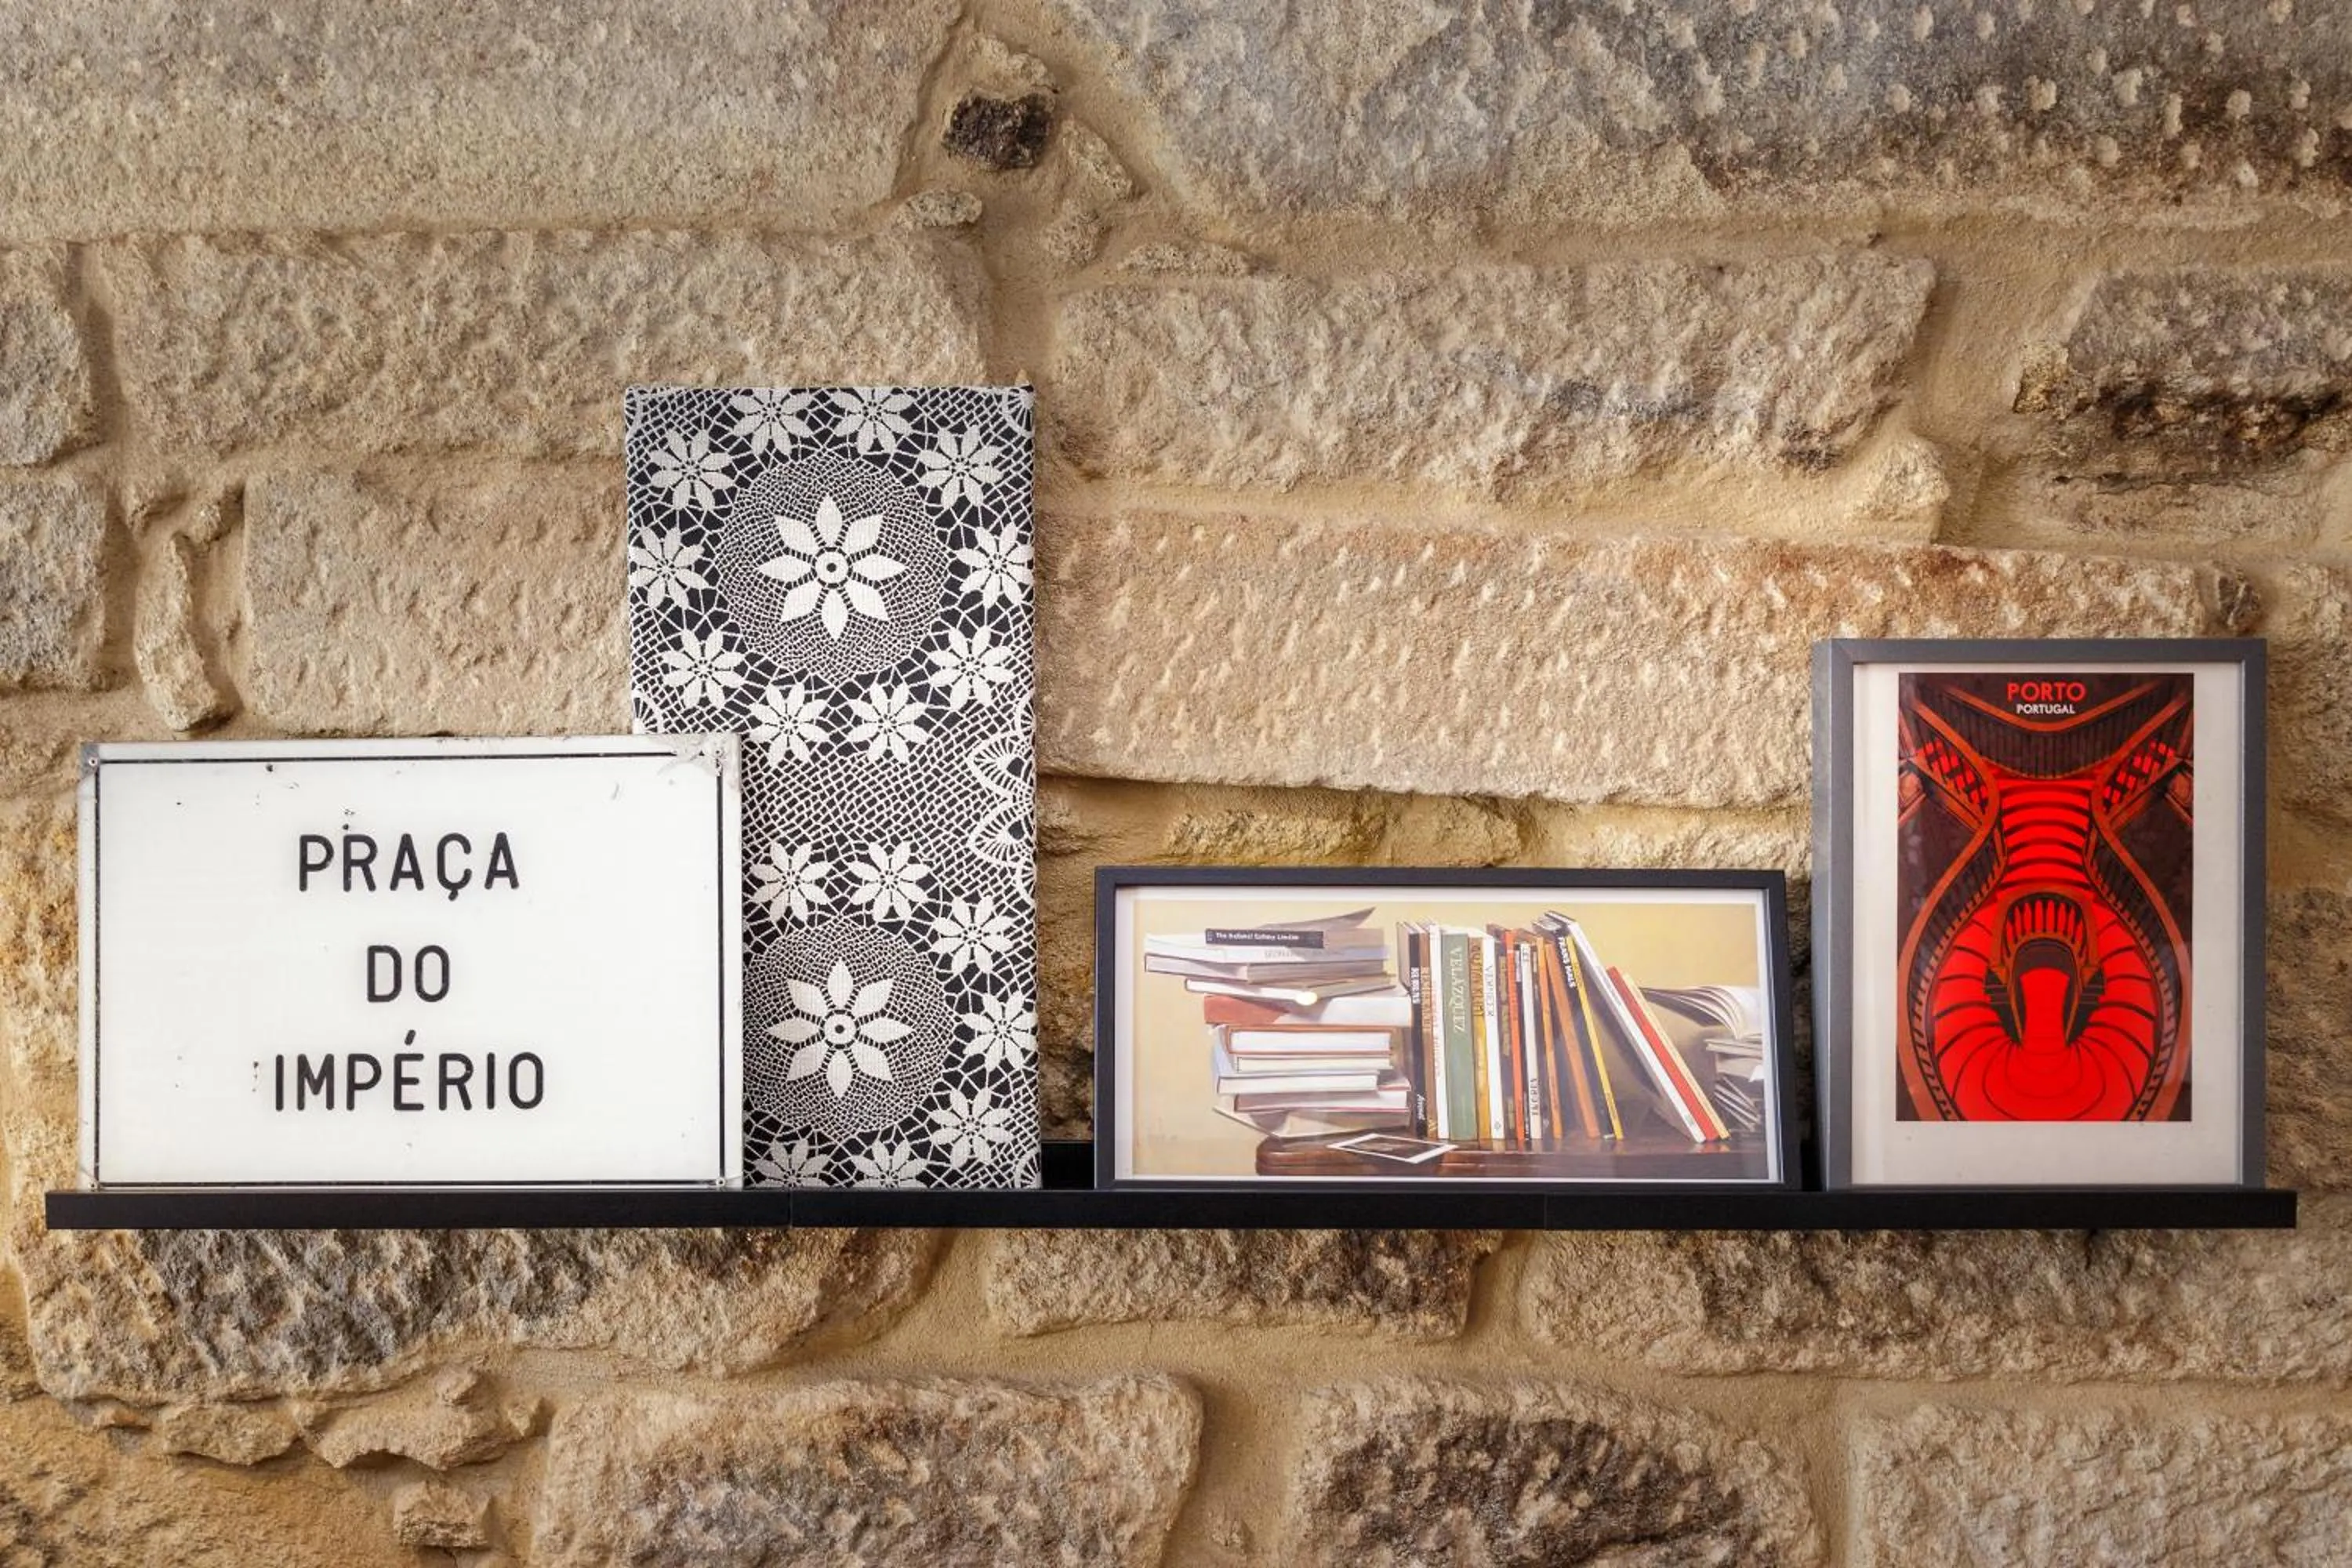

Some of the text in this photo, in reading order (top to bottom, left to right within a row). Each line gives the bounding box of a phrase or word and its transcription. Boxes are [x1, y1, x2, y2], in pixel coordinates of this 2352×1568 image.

[2007, 681, 2085, 702] PORTO
[2016, 703, 2076, 714] PORTUGAL
[298, 832, 521, 901] PRAÇA
[366, 945, 451, 1004] DO
[274, 1029, 544, 1112] IMPÉRIO
